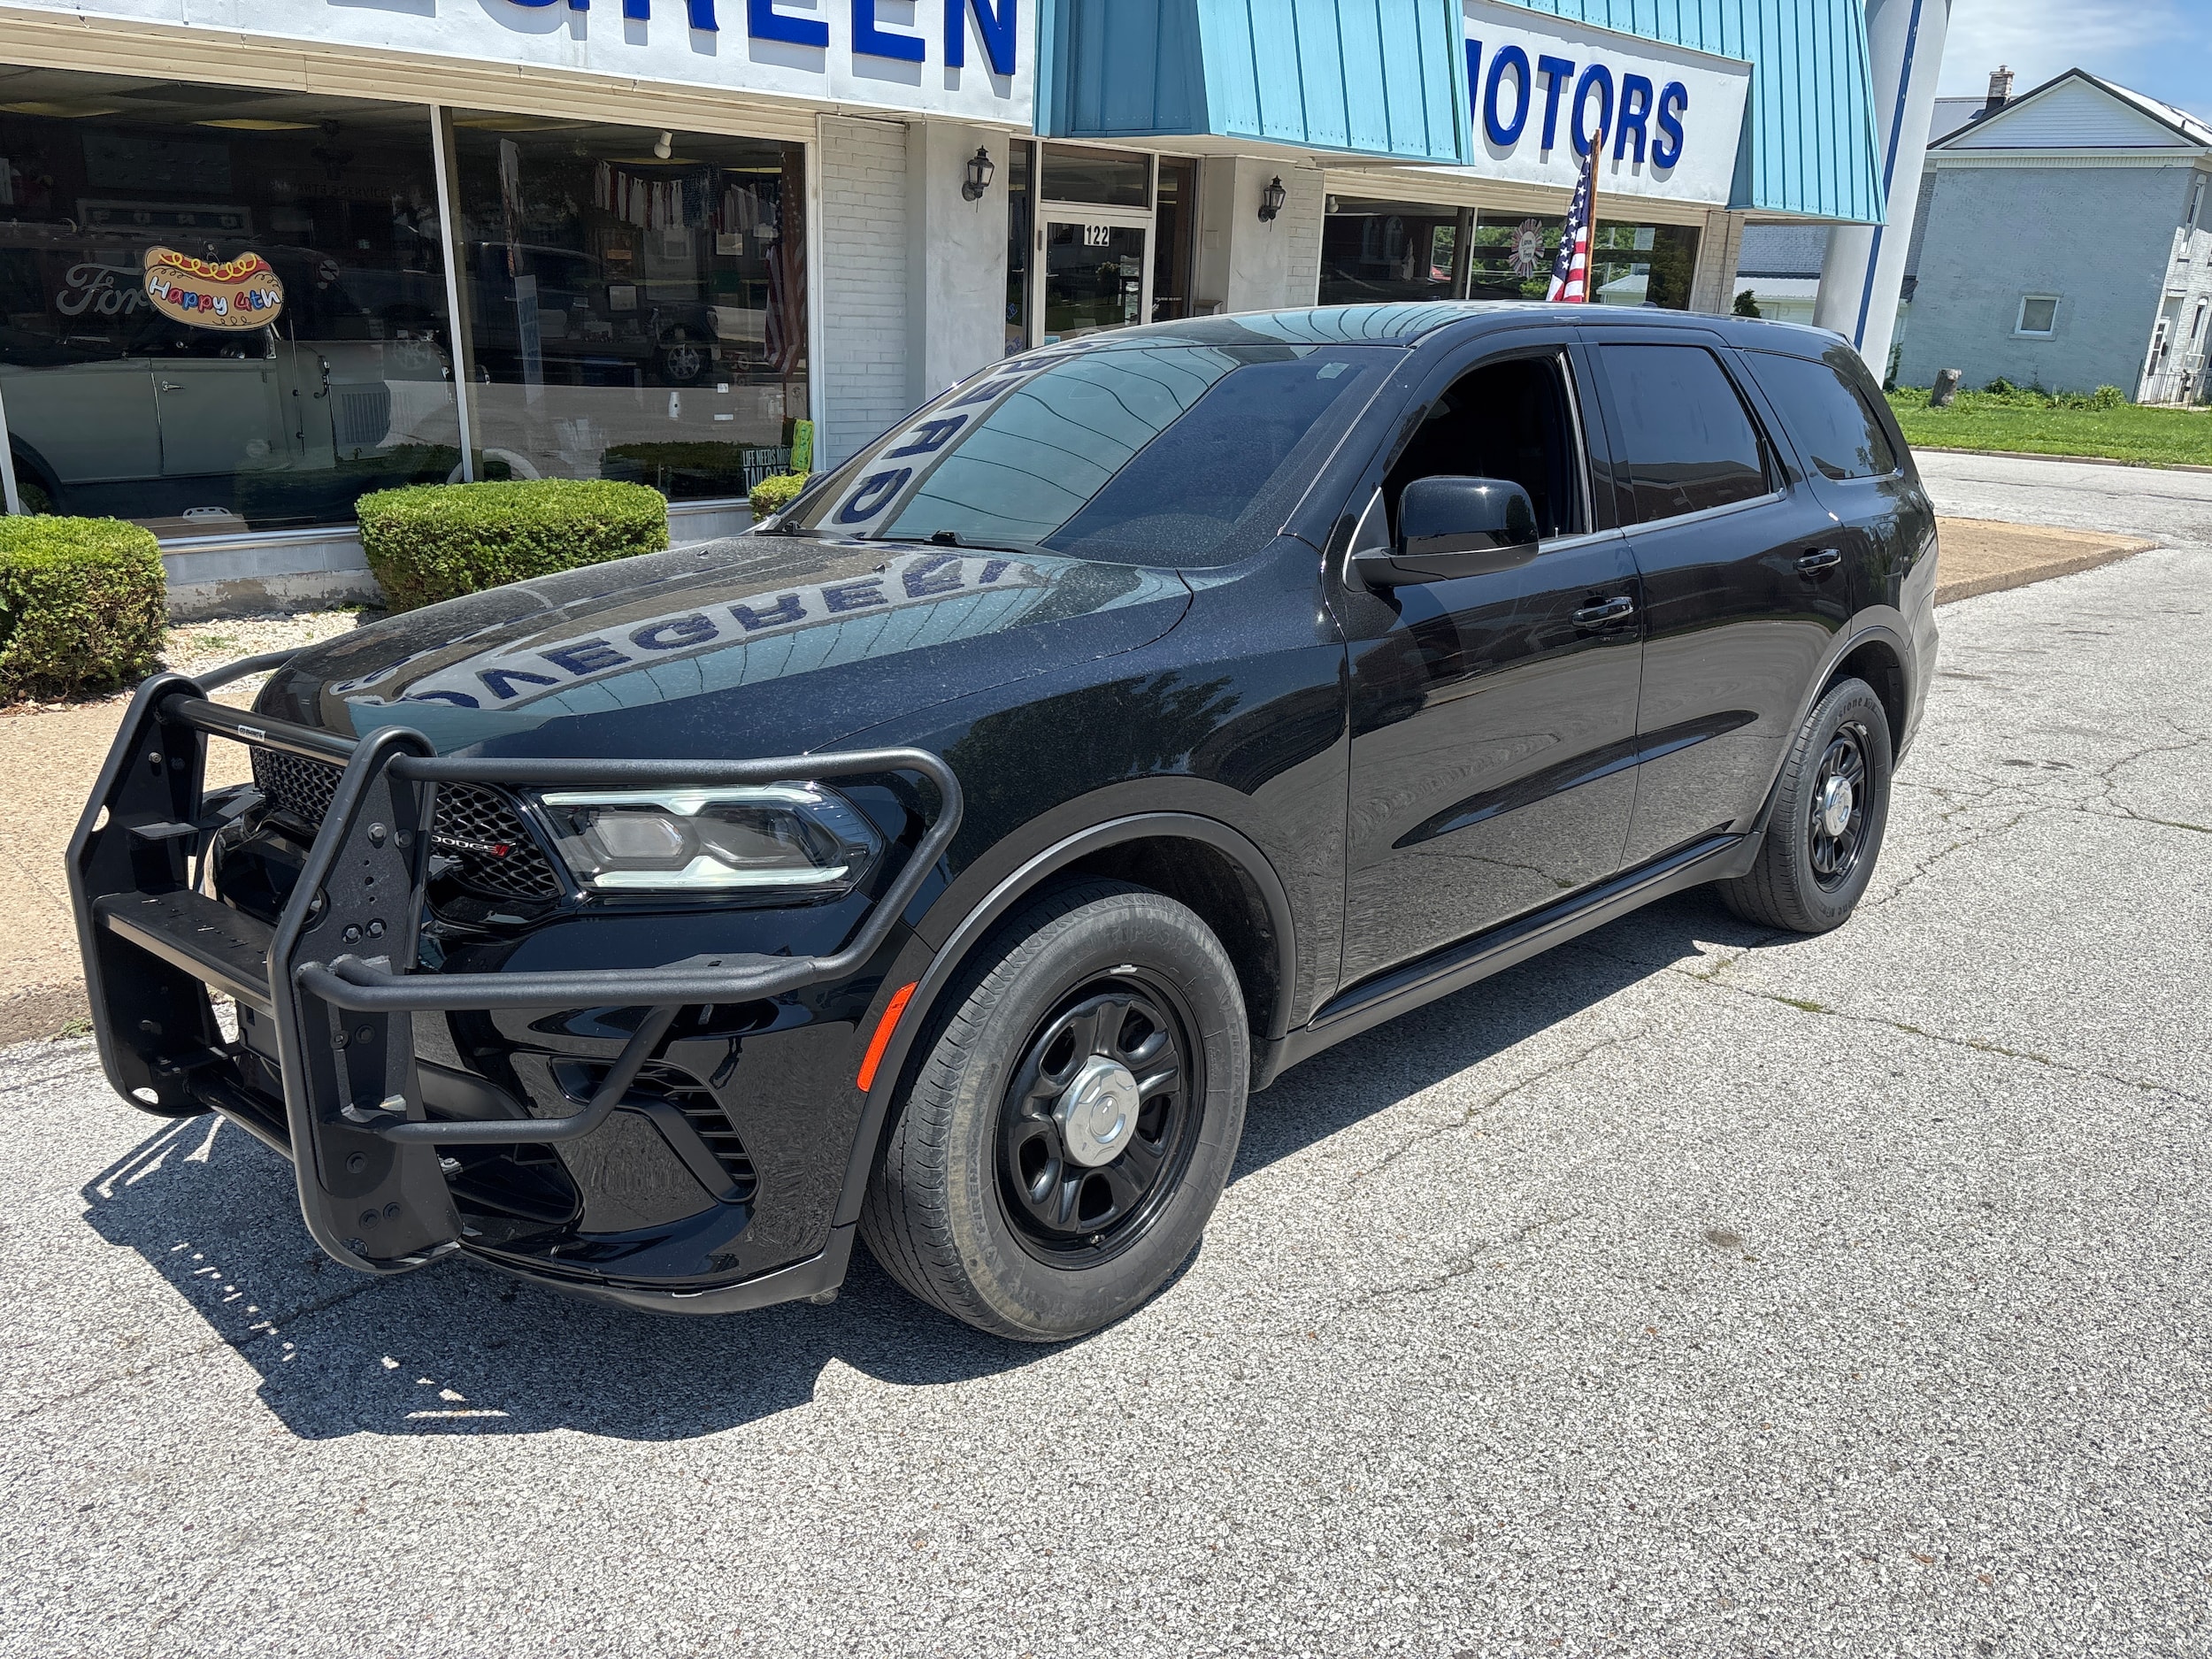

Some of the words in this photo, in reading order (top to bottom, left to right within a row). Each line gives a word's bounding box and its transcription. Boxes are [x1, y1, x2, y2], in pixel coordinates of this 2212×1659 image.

[1465, 38, 1688, 168] OTORS
[1086, 225, 1109, 245] 122
[56, 263, 152, 316] For
[149, 275, 228, 316] Happy
[234, 288, 281, 311] 4th
[742, 449, 756, 467] LIFE
[757, 449, 776, 466] NEEDS
[432, 834, 498, 855] DODGE
